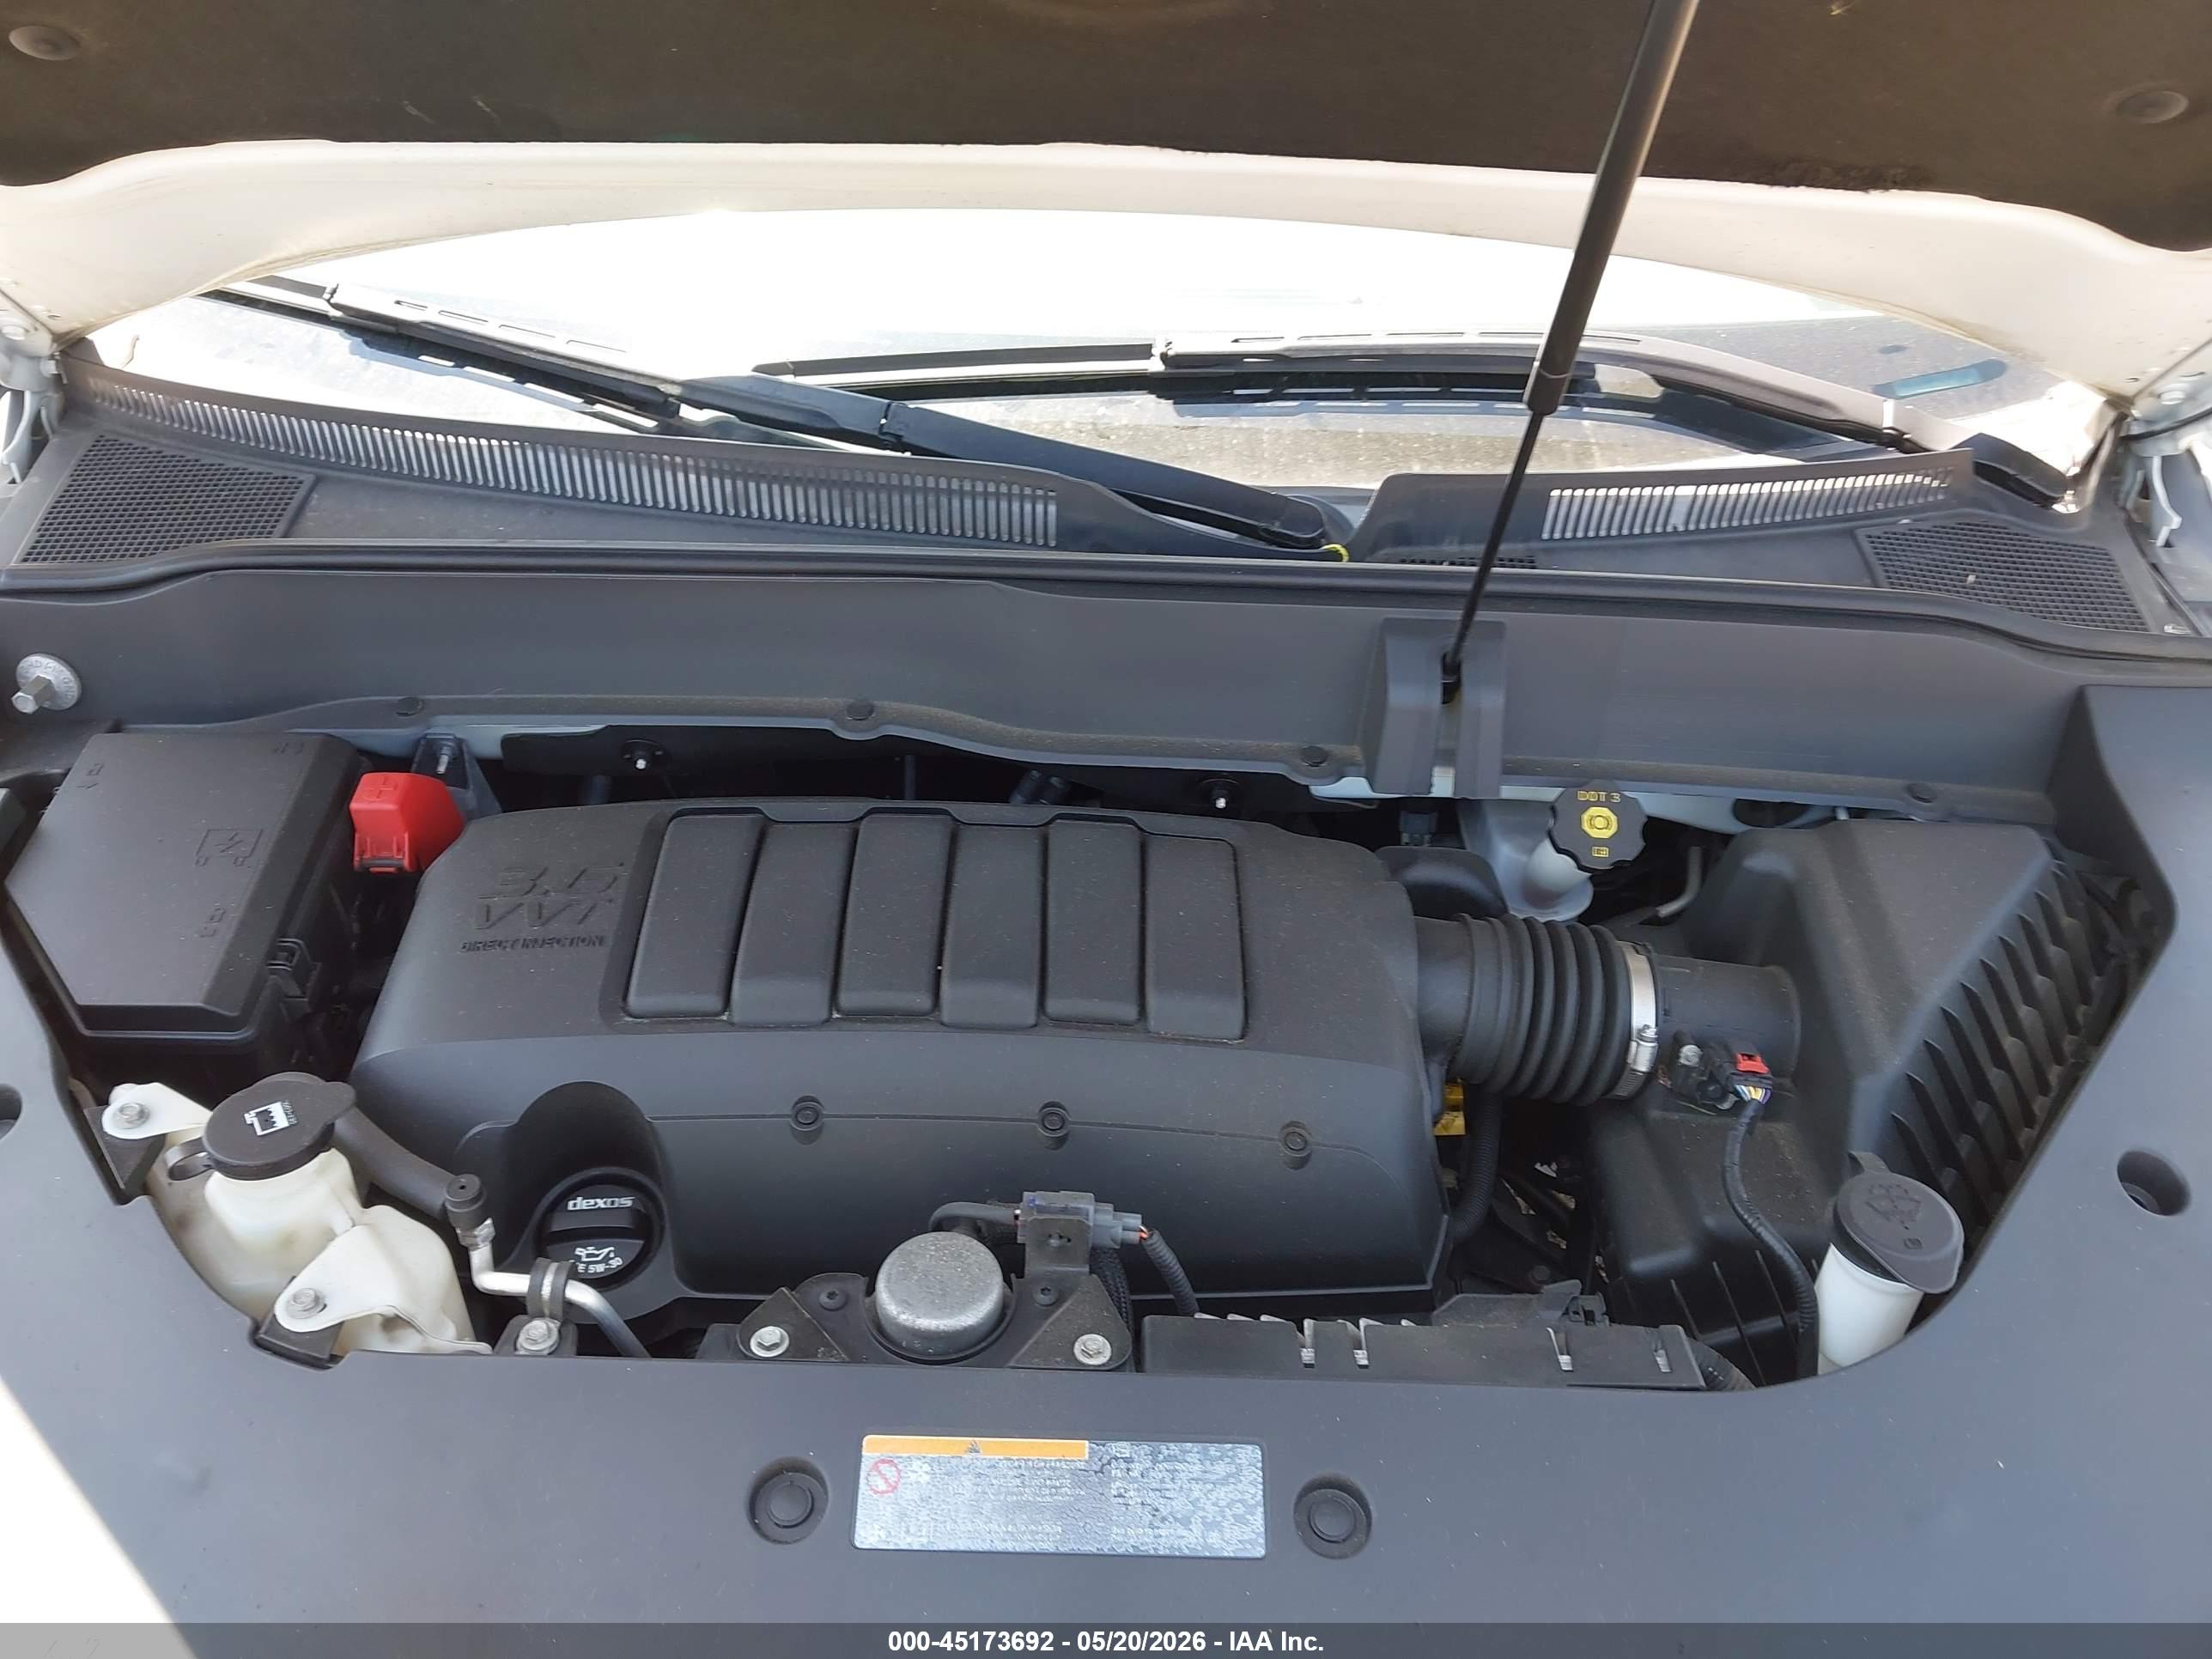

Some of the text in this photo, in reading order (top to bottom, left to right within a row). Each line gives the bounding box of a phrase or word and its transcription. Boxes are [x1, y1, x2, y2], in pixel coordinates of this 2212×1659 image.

[1577, 790, 1621, 803] DOT 3
[567, 1196, 635, 1211] dexos
